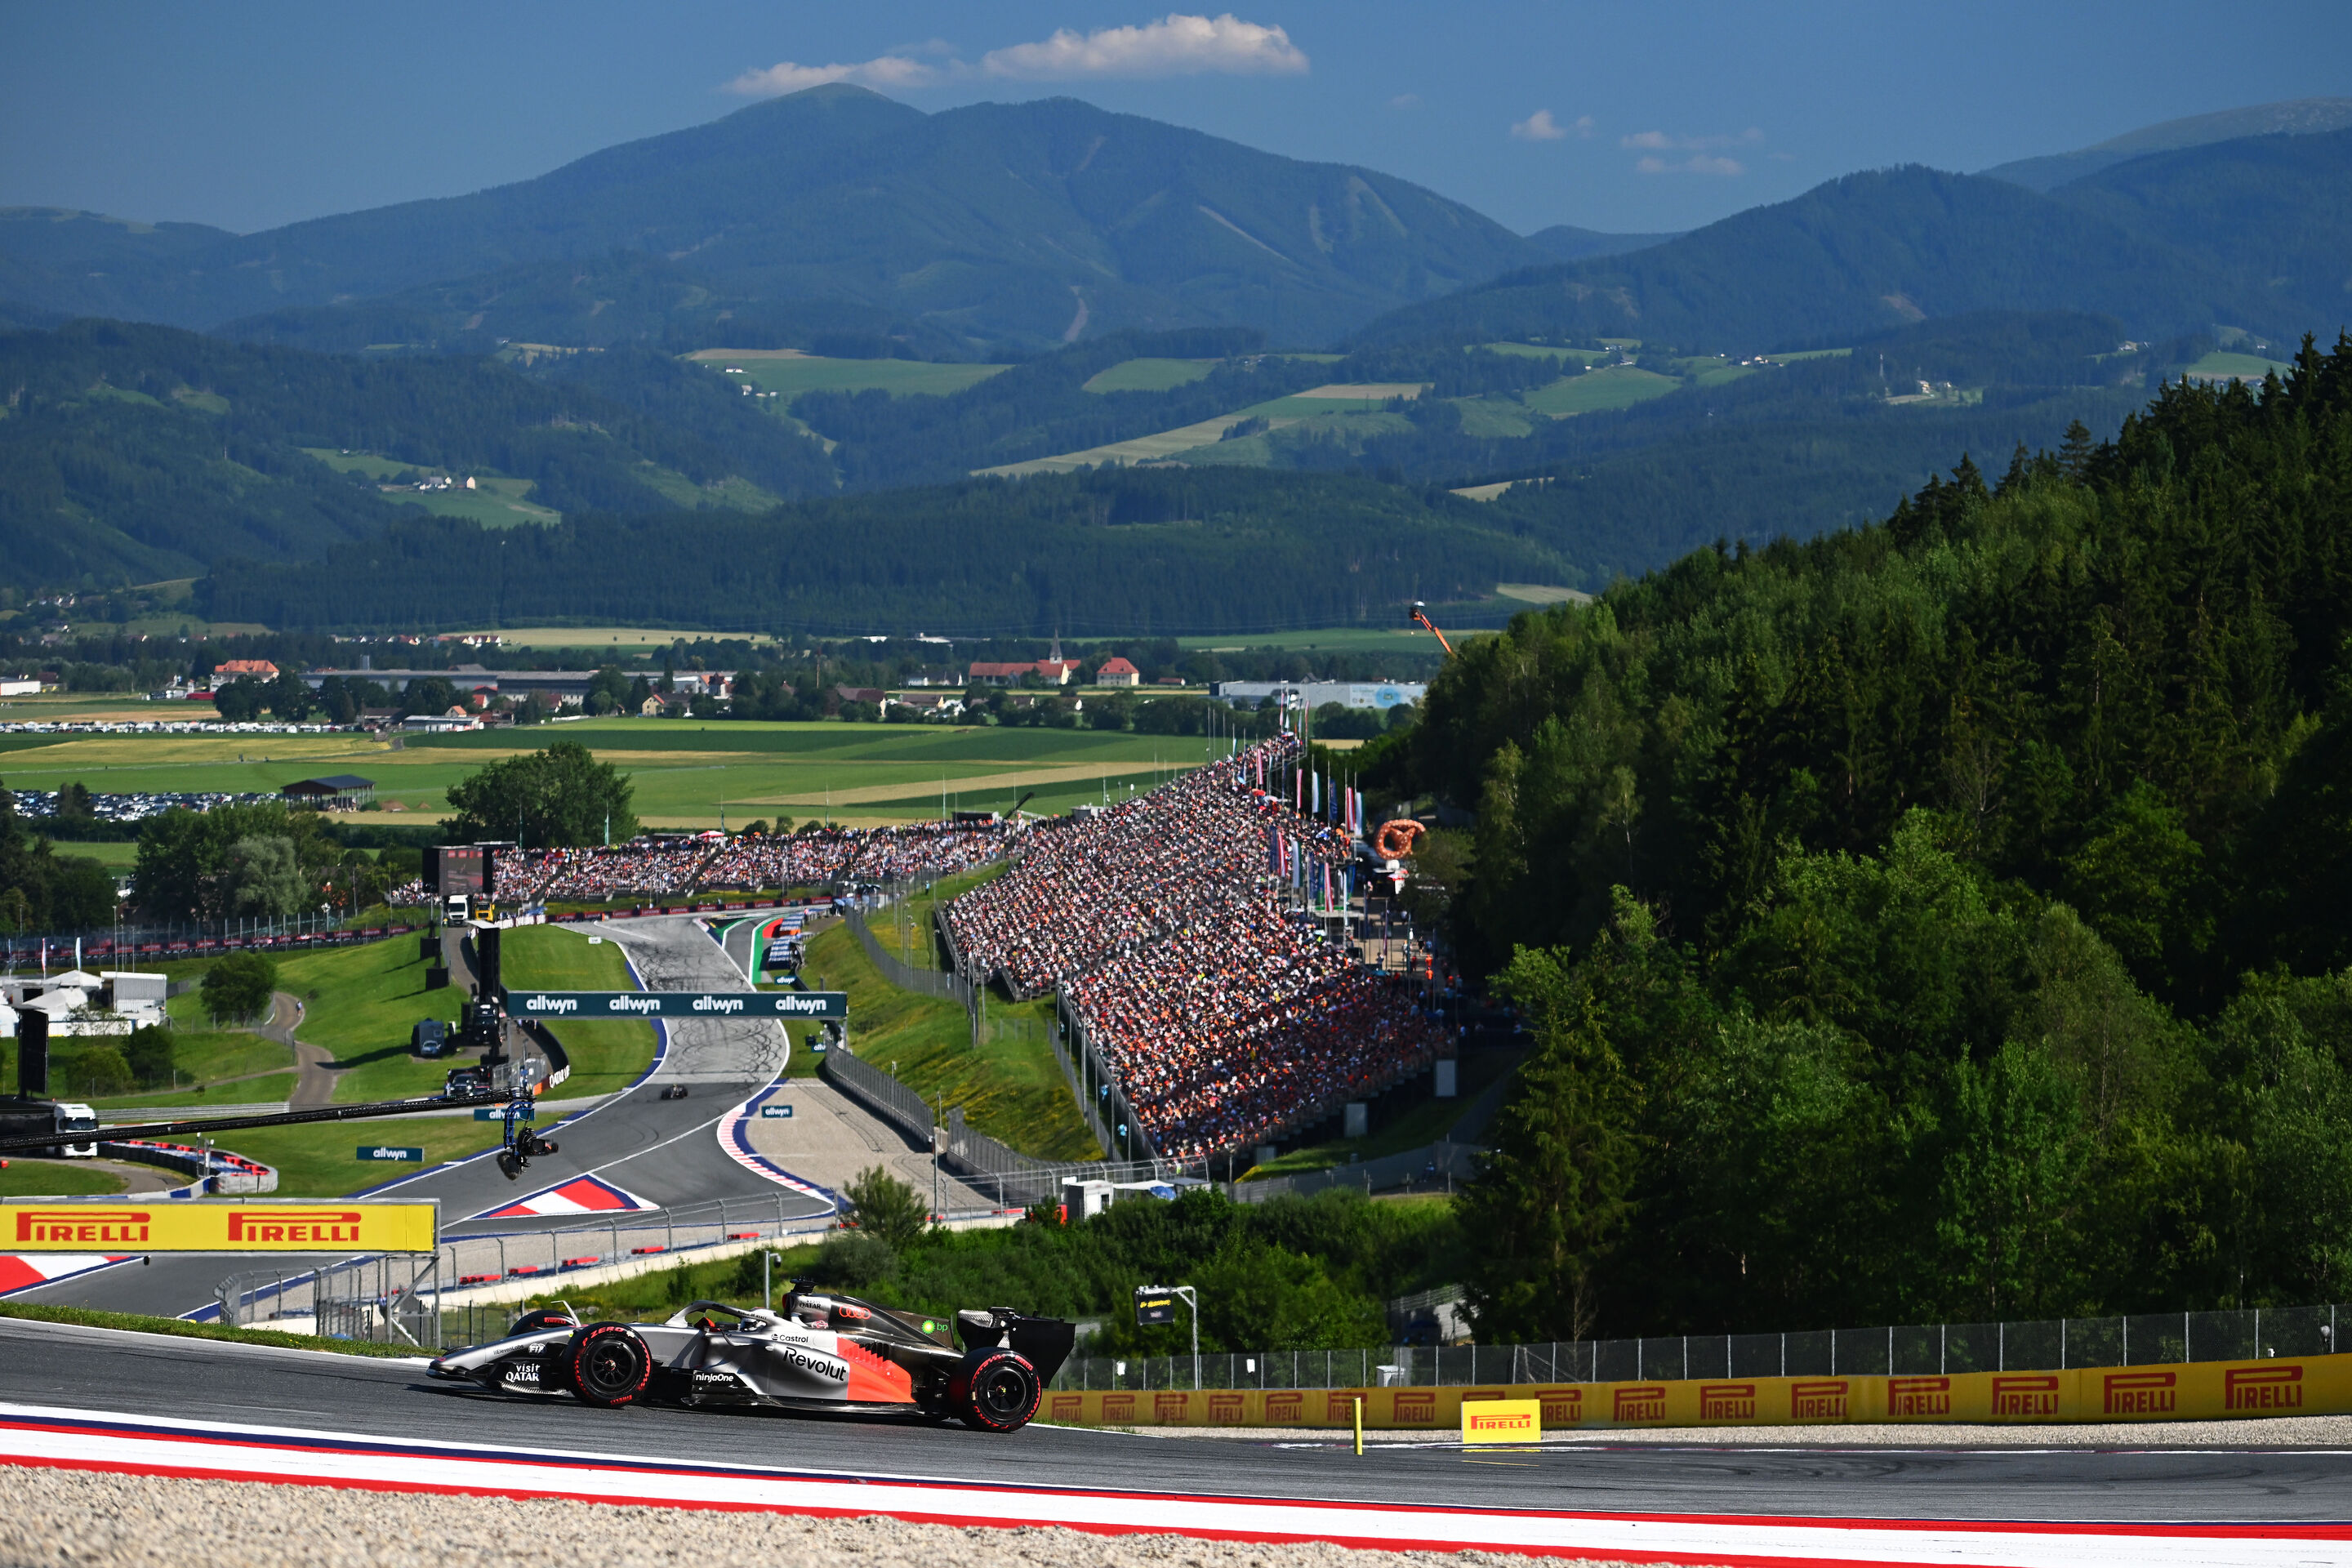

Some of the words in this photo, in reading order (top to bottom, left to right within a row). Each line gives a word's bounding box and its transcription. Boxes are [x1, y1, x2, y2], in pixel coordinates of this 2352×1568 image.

[526, 995, 577, 1014] allwyn
[609, 995, 661, 1014] allwyn
[693, 996, 743, 1014] allwyn
[776, 996, 826, 1014] allwyn
[764, 1107, 791, 1117] allwyn
[373, 1147, 407, 1160] allwyn
[16, 1212, 151, 1241] PIRELLI
[228, 1212, 362, 1241] PIRELLI
[590, 1326, 626, 1339] ZERO
[779, 1334, 809, 1343] Castrol
[937, 1322, 948, 1333] bp
[506, 1371, 540, 1383] QATAR
[516, 1363, 541, 1373] visit
[695, 1373, 734, 1383] ninjaOne
[782, 1347, 847, 1382] Revolut
[1791, 1381, 1848, 1419] PIRELLI
[1888, 1377, 1950, 1416] PIRELLI
[1991, 1376, 2059, 1414] PIRELLI
[2104, 1372, 2176, 1414] PIRELLI
[2225, 1365, 2303, 1410] PIRELLI
[1052, 1395, 1083, 1422] PIRELLI
[1102, 1394, 1135, 1421] PIRELLI
[1155, 1393, 1188, 1421] PIRELLI
[1209, 1394, 1245, 1422] PIRELLI
[1266, 1392, 1303, 1422] PIRELLI
[1393, 1392, 1436, 1422] PIRELLI
[1613, 1387, 1666, 1422] PIRELLI
[1700, 1384, 1755, 1420] PIRELLI
[1471, 1414, 1531, 1430] PIRELLI
